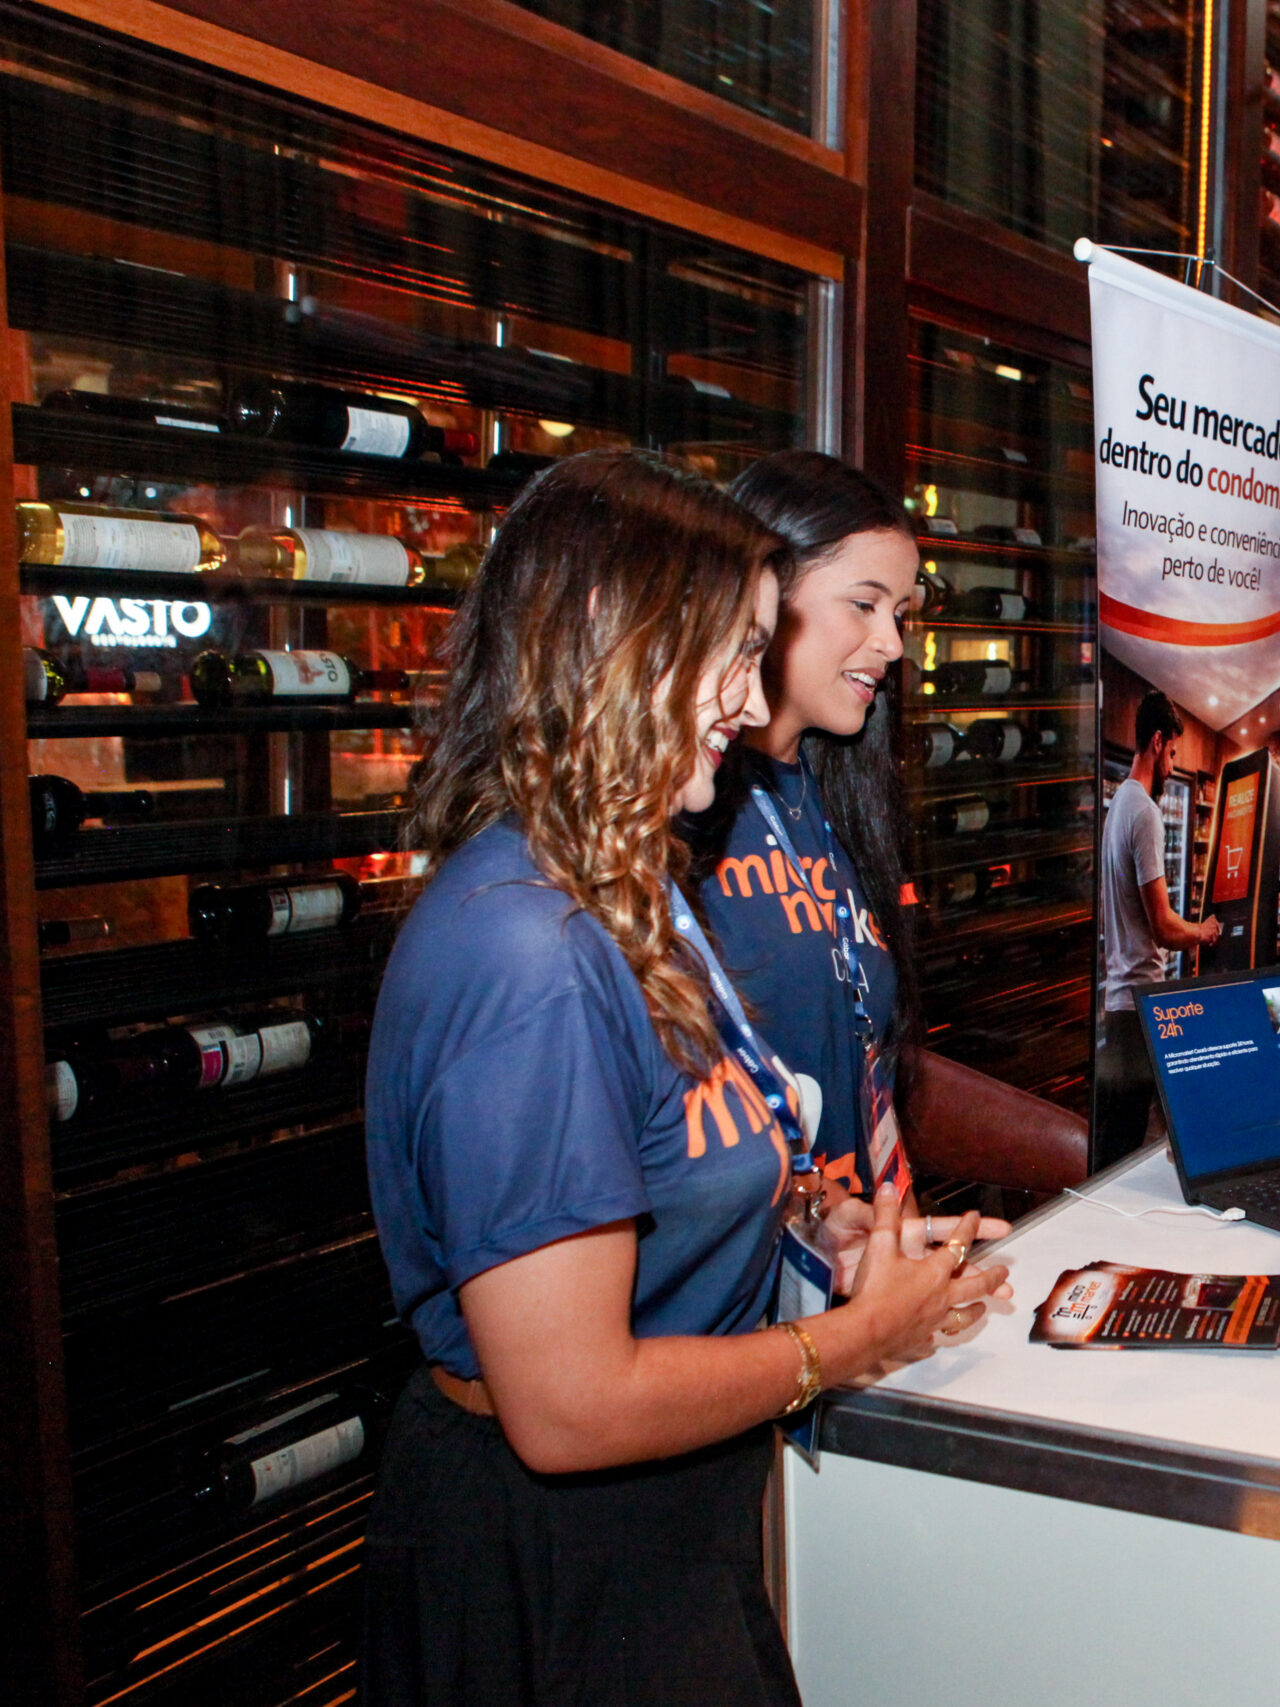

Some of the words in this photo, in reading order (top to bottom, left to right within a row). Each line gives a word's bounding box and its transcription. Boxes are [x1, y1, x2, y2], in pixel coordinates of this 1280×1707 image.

[1136, 373, 1187, 430] Seu
[1099, 428, 1172, 479] dentro
[1176, 449, 1203, 487] do
[1122, 500, 1195, 542] Inovação
[1199, 523, 1207, 542] e
[1162, 555, 1204, 581] perto
[1207, 559, 1225, 584] de
[1228, 567, 1262, 592] você!
[52, 595, 212, 638] VASTO
[711, 972, 728, 1000] Gabor
[1153, 1002, 1205, 1024] Suporte
[1158, 1022, 1184, 1039] 24h
[737, 1048, 760, 1073] Gabor
